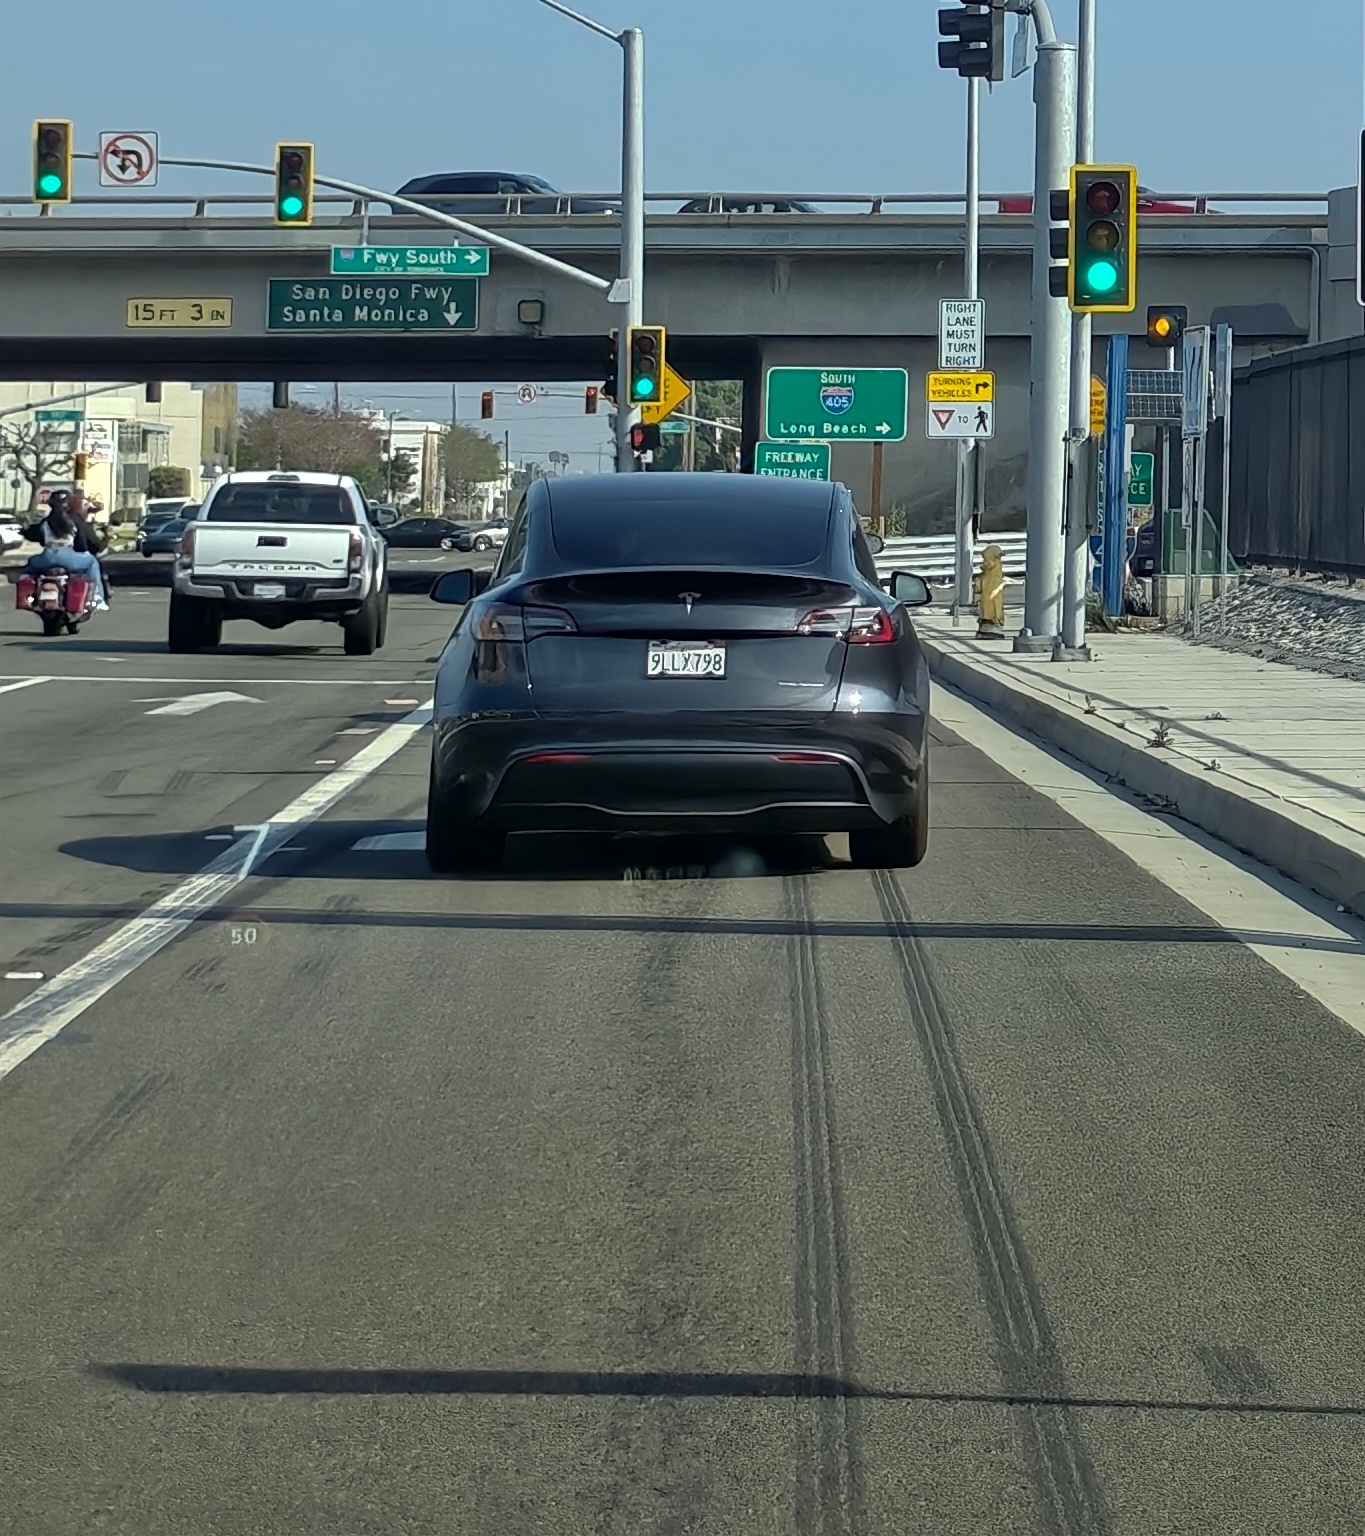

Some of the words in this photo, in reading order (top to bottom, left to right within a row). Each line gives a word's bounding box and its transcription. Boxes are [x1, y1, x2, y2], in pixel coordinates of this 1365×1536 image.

[363, 249, 399, 267] Fwy
[405, 249, 457, 264] South
[291, 283, 330, 300] San
[341, 283, 400, 306] Diego
[411, 283, 453, 306] Fwy
[134, 303, 155, 321] 15
[159, 309, 178, 321] FT
[190, 303, 204, 321] 3
[282, 305, 343, 322] Santa
[354, 305, 430, 322] Monica
[945, 303, 977, 313] RIGHT
[947, 316, 976, 327] LANE
[946, 329, 976, 340] MUST
[947, 342, 977, 353] TURN
[945, 355, 977, 366] RIGHT
[820, 371, 856, 384] SOUTH
[826, 396, 849, 408] 405
[957, 415, 969, 424] TO
[780, 422, 815, 436] Long
[823, 422, 867, 434] Beach
[765, 451, 820, 463] FREEWAY
[651, 652, 723, 672] 9LLX798
[231, 927, 257, 945] 50
